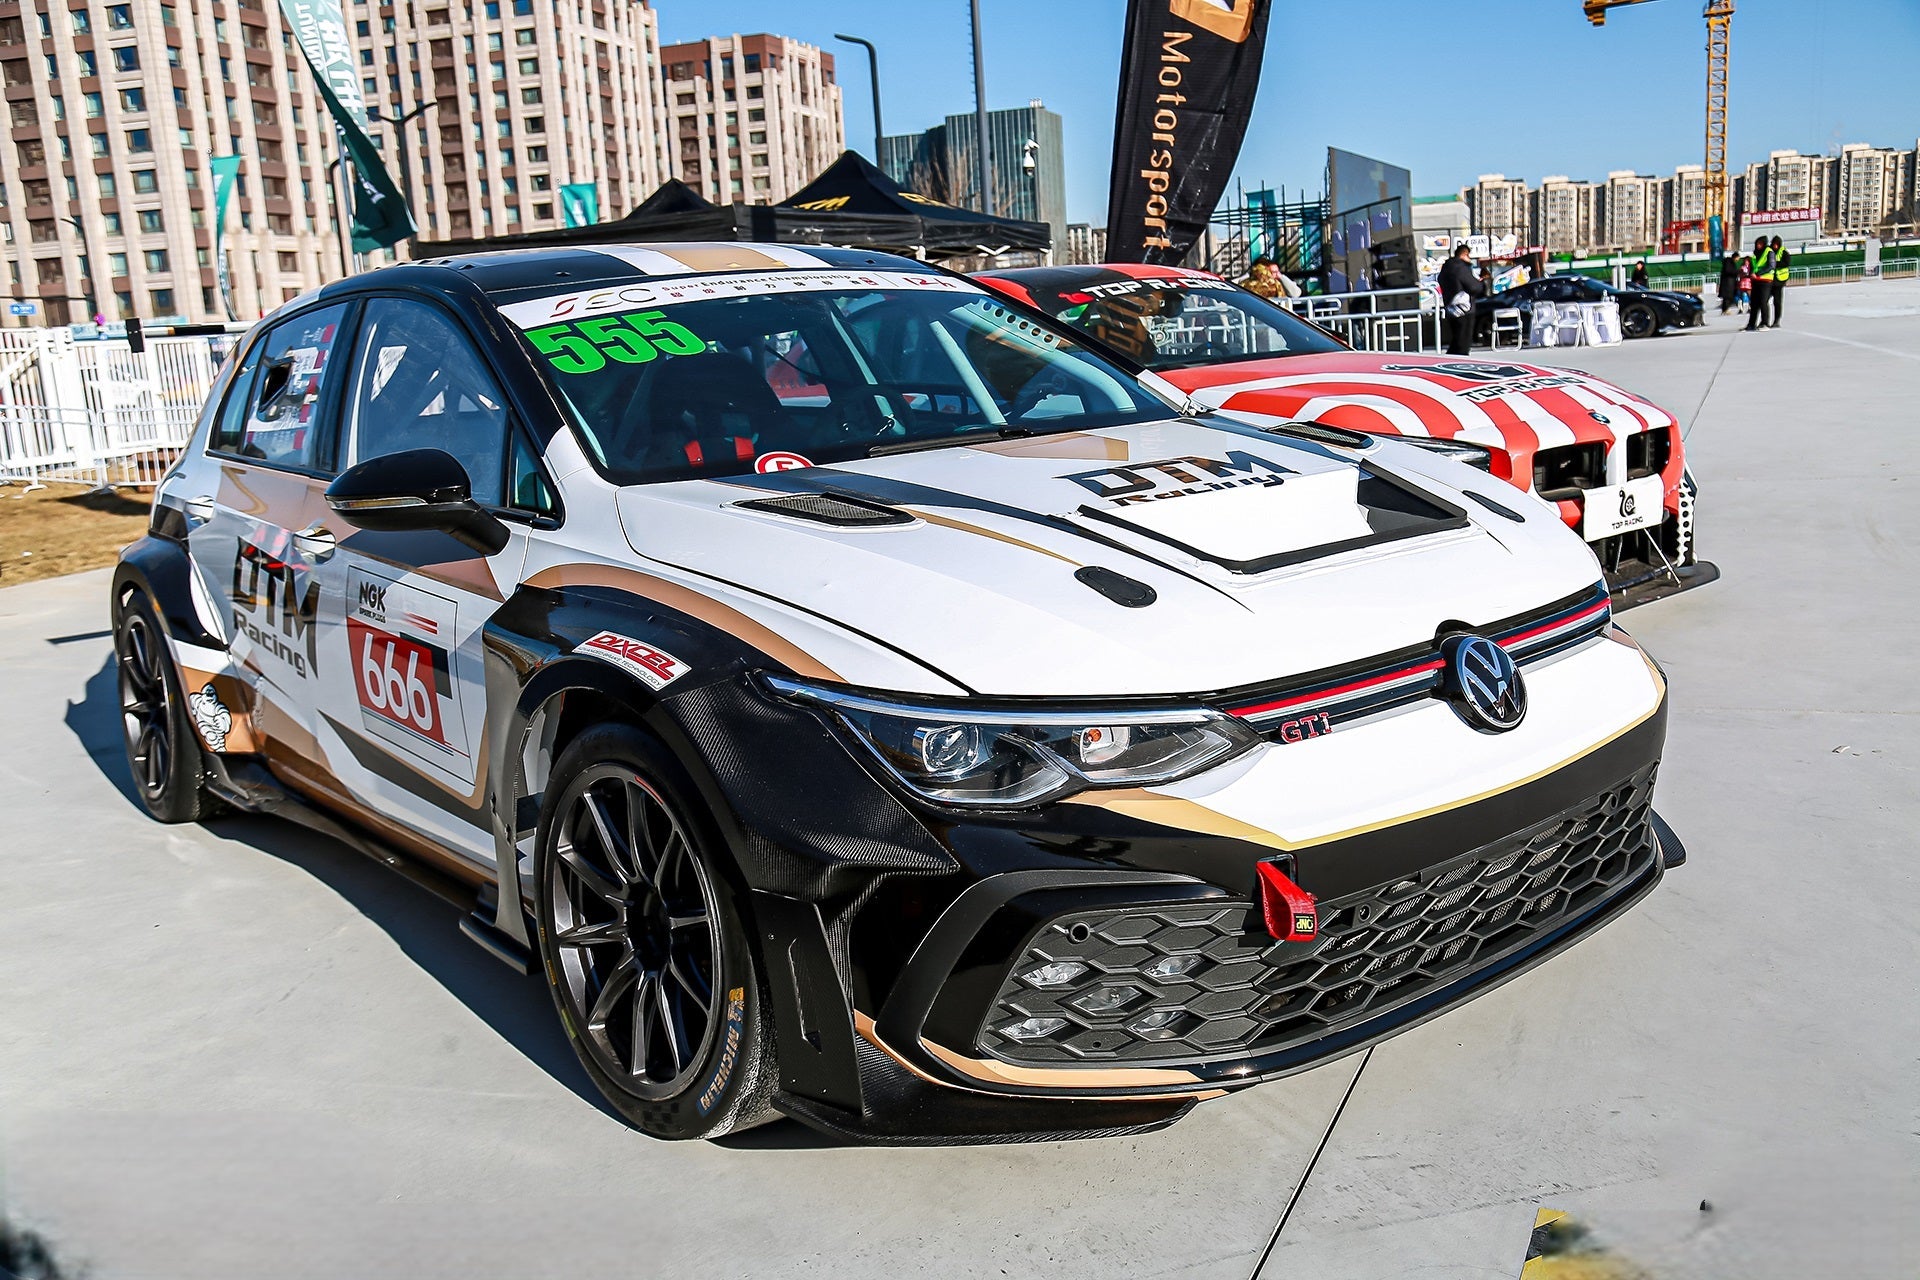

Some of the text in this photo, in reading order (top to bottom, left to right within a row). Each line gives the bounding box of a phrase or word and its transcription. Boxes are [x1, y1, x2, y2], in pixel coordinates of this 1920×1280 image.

[1141, 31, 1193, 250] Motorsport
[661, 284, 699, 292] Super
[701, 278, 766, 287] Endurance
[768, 273, 852, 282] Championship
[1080, 278, 1237, 299] TOP RACING
[523, 311, 706, 374] 555
[1456, 376, 1587, 401] TOP RACING
[1051, 450, 1302, 498] DTM
[1612, 516, 1643, 530] TOP RACING
[233, 535, 321, 680] DTM
[359, 581, 387, 613] NGK
[233, 609, 307, 680] Racing
[591, 634, 677, 678] DIXCEL
[362, 632, 433, 731] 666
[621, 660, 663, 686] TECHNOLOGY
[1281, 712, 1333, 744] GTI
[700, 1025, 740, 1111] MICHELIN
